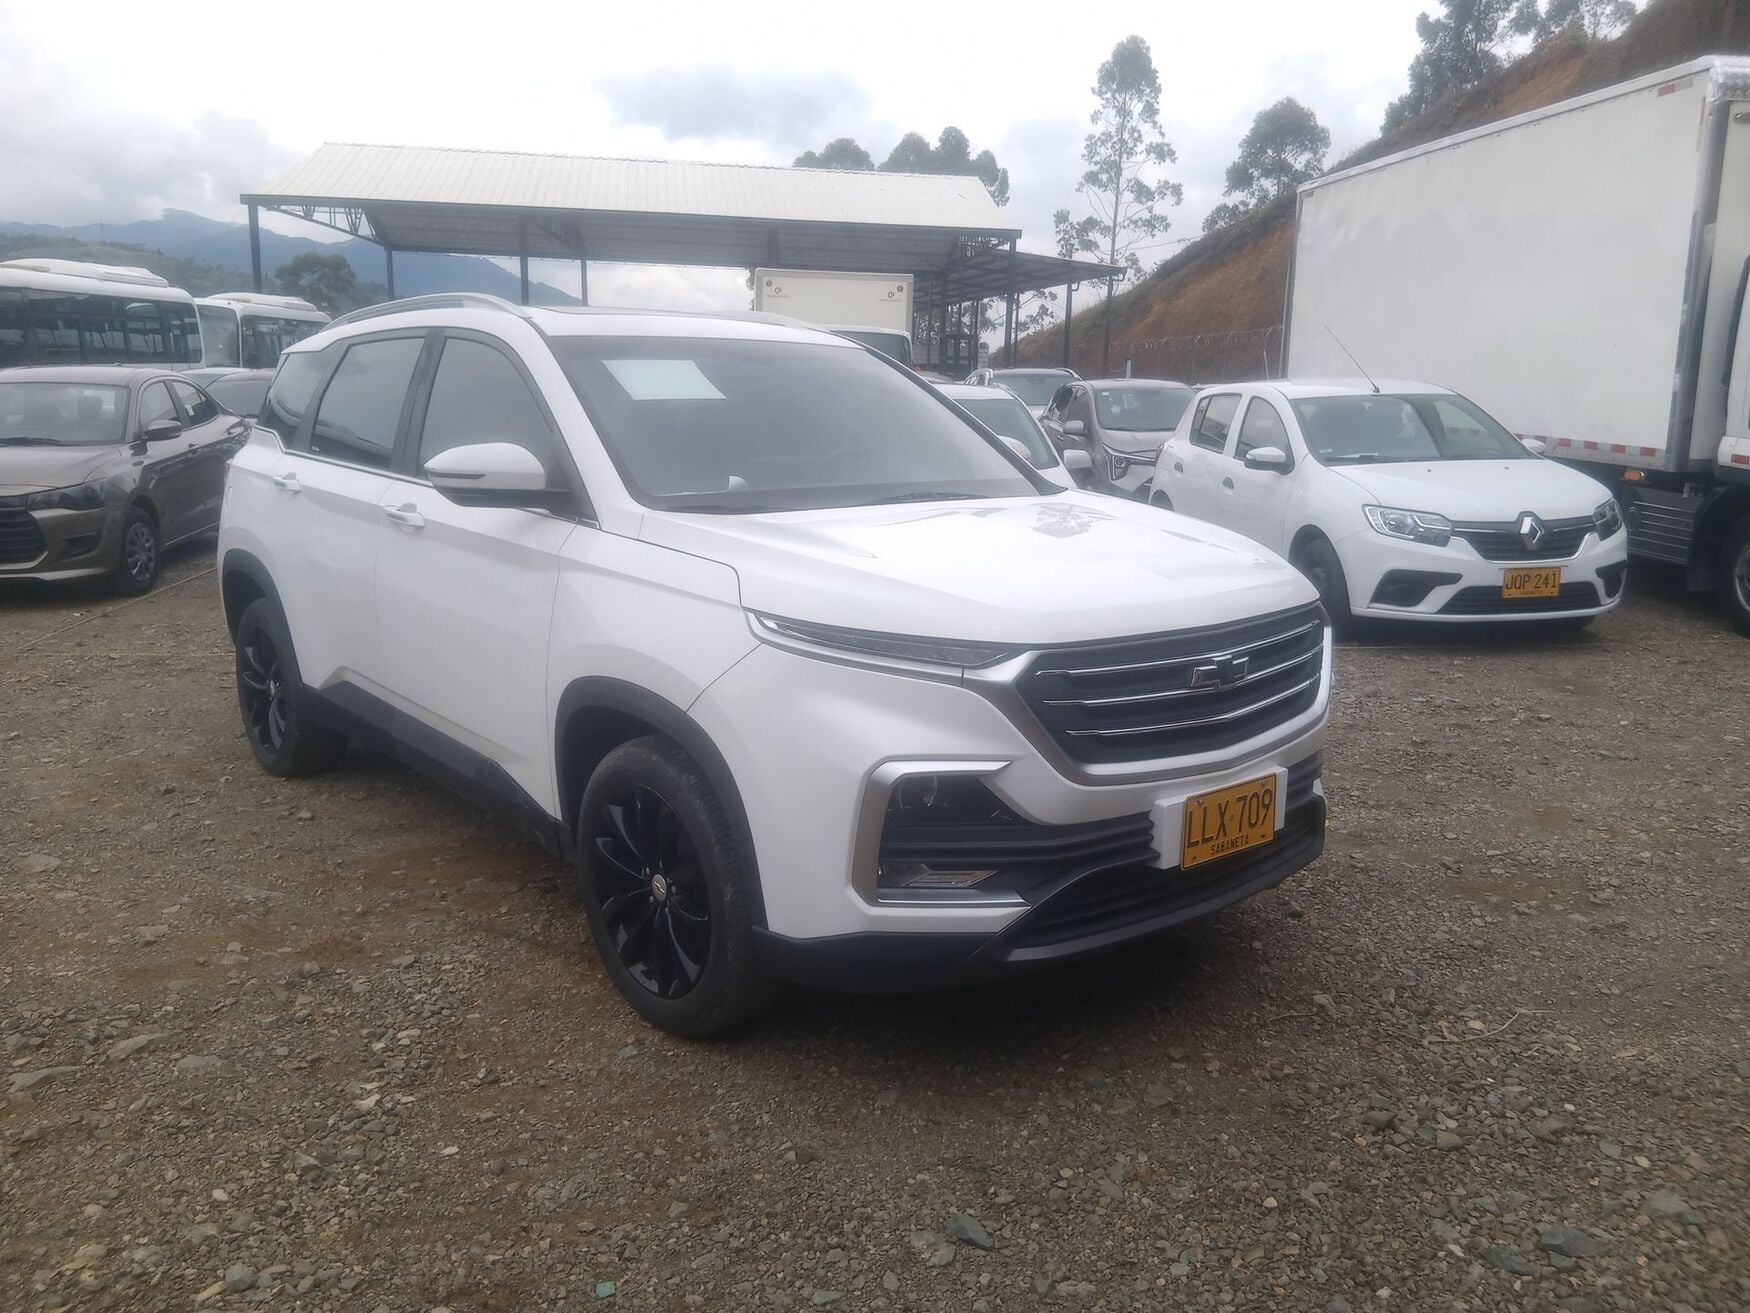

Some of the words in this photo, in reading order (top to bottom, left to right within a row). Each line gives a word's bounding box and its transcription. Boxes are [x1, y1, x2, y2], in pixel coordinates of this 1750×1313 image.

[1534, 573, 1557, 589] 241
[1186, 800, 1230, 848] LLX
[1236, 788, 1274, 833] 709
[1210, 834, 1249, 855] SABANETA
